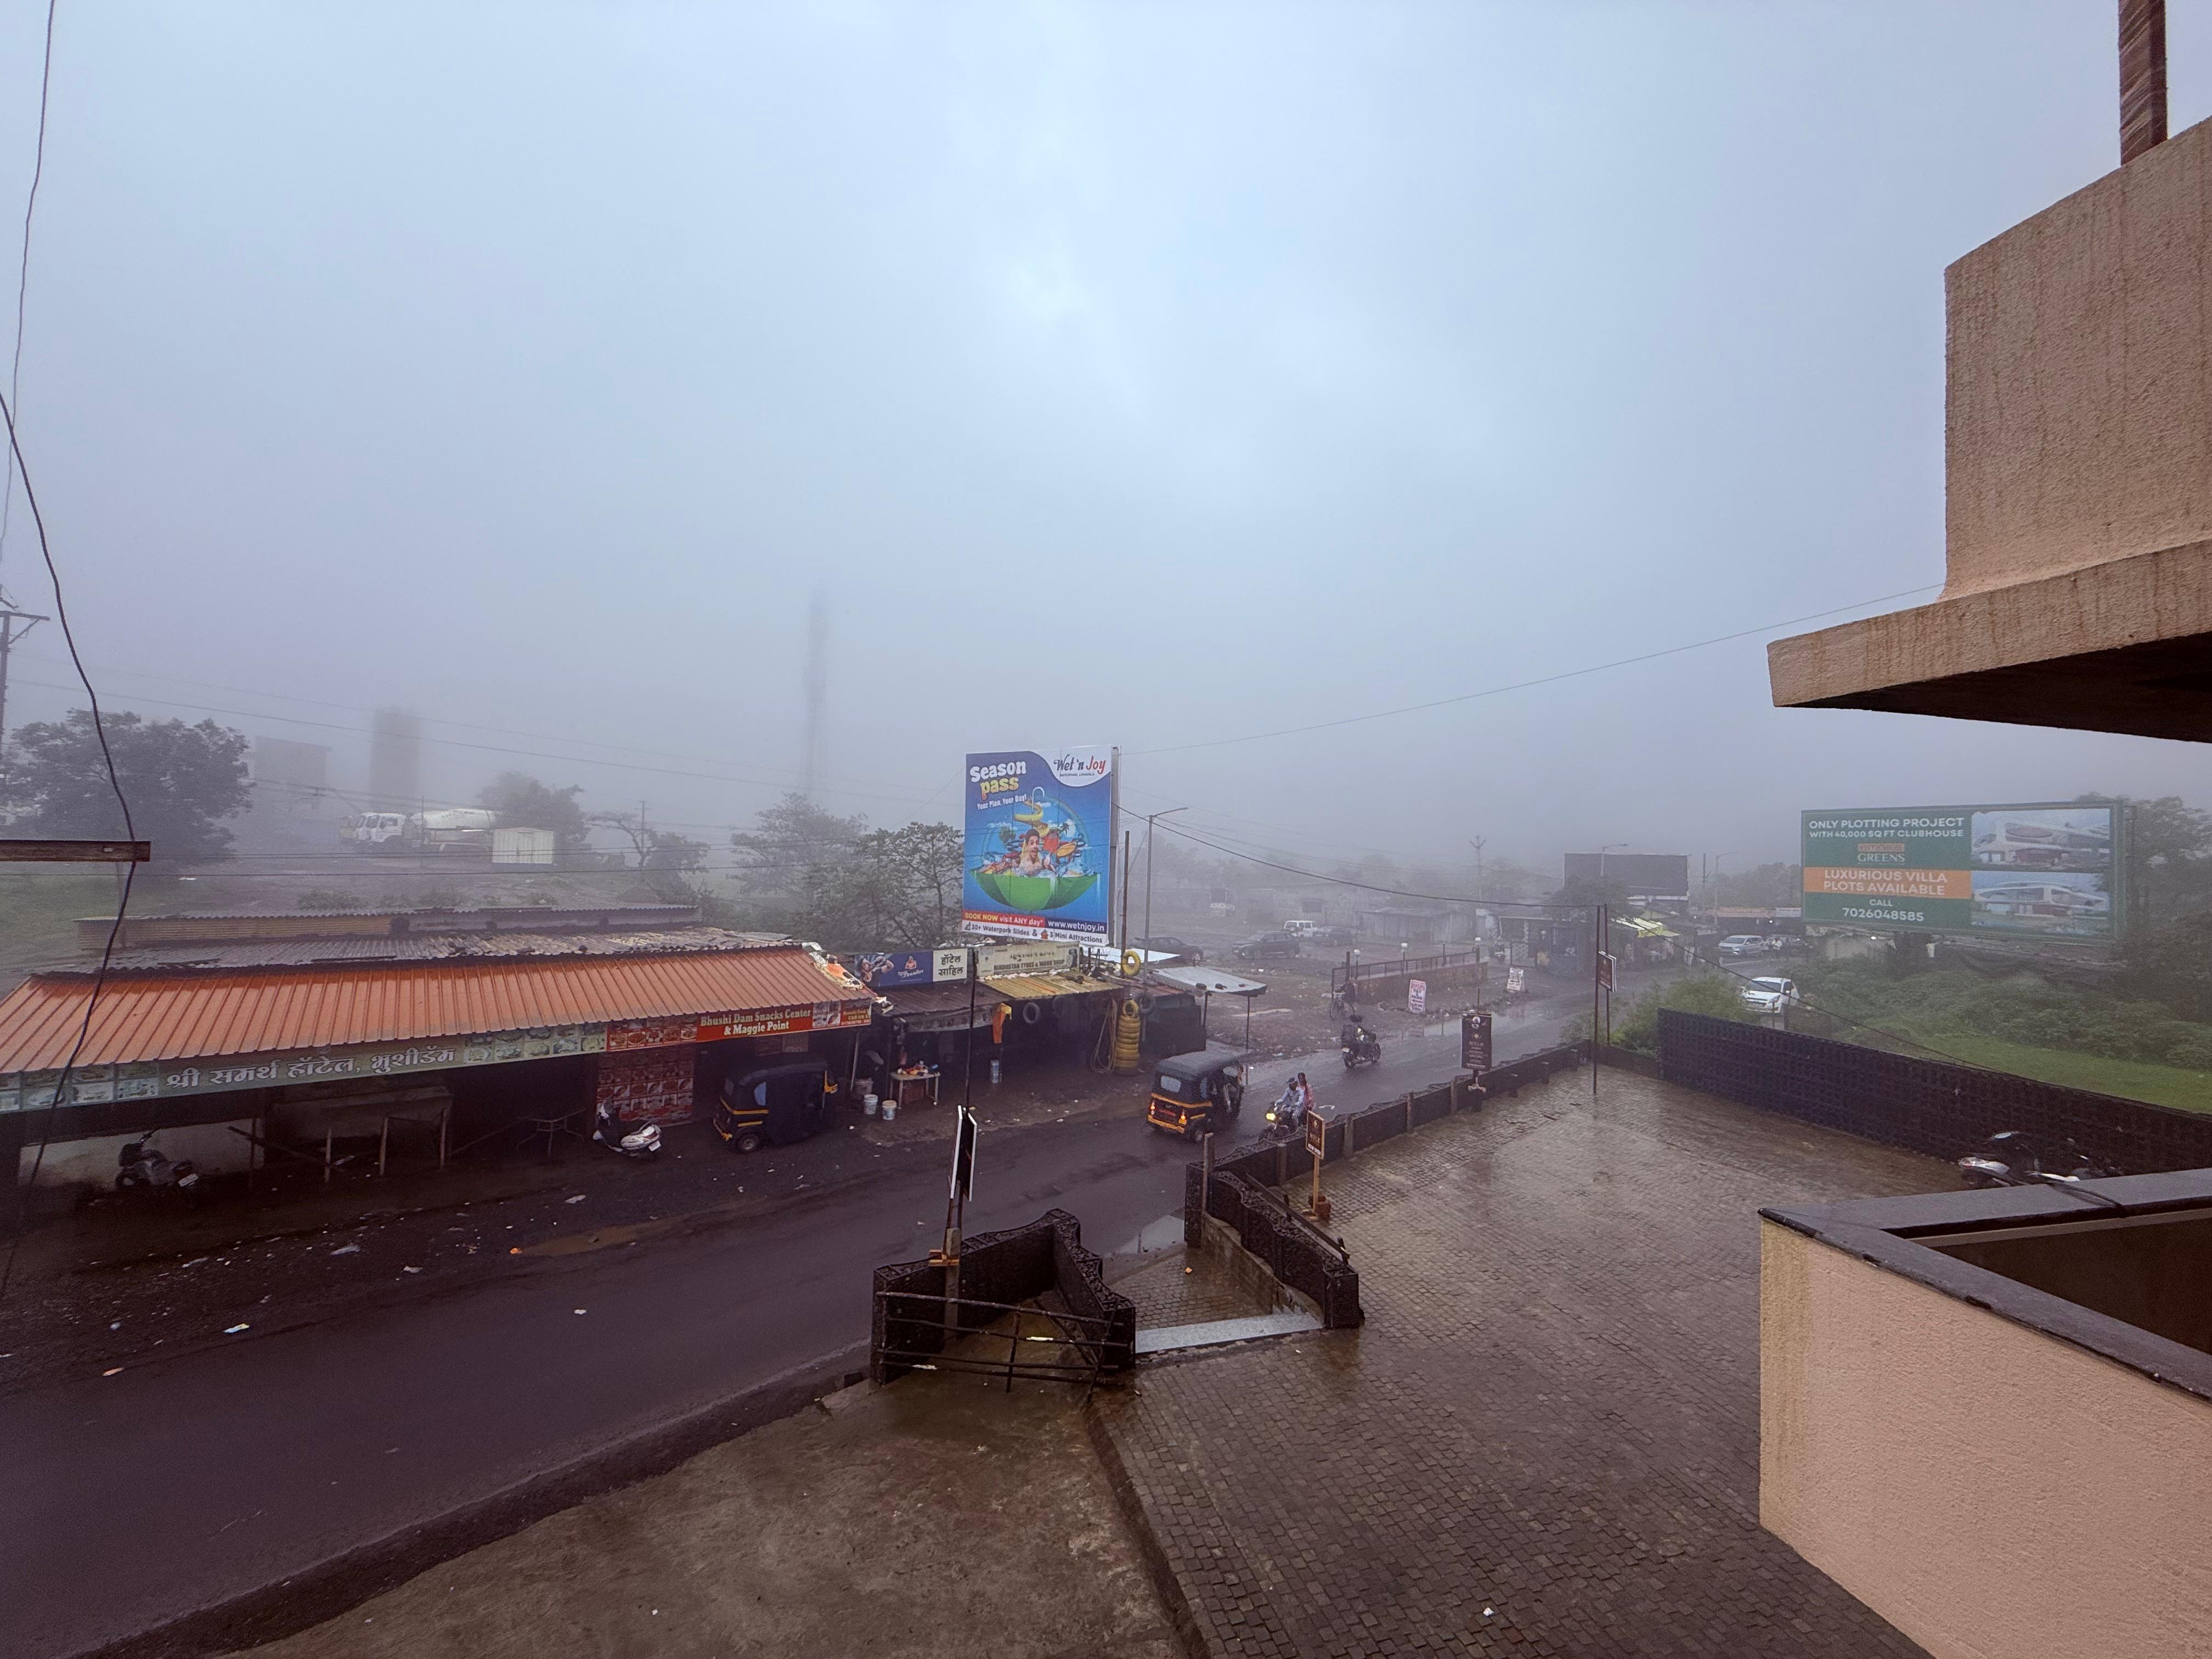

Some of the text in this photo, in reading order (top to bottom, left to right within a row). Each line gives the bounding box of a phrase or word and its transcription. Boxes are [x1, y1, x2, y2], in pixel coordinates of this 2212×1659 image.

[1054, 754, 1074, 771] Wet
[1086, 755, 1106, 774] Joy
[969, 761, 1026, 782] Season
[980, 777, 1019, 800] pass
[1015, 793, 1027, 803] Day!
[1809, 817, 1964, 828] ONLY PLOTTING PROJECT
[1897, 829, 1963, 837] CLUBHOUSE
[1857, 853, 1905, 862] GREENS
[1824, 869, 1948, 883] LUXURIOUS VILLA
[1824, 881, 1945, 895] PLOTS AVAILABLE
[1869, 899, 1893, 907] CALL
[1842, 907, 1925, 922] 7026048585
[983, 924, 1011, 934] Waterpark
[1013, 928, 1029, 936] Slides
[1048, 920, 1104, 932] www.wetnjoy.in
[1069, 934, 1103, 943] Attractions
[940, 953, 961, 965] हॉटेल
[938, 965, 963, 977] साहिल
[700, 1008, 811, 1027] Bhushi Dam Snacks Center
[724, 1020, 789, 1036] & Maggie Point
[166, 1066, 201, 1088] श्री
[210, 1059, 281, 1085] समर्थ
